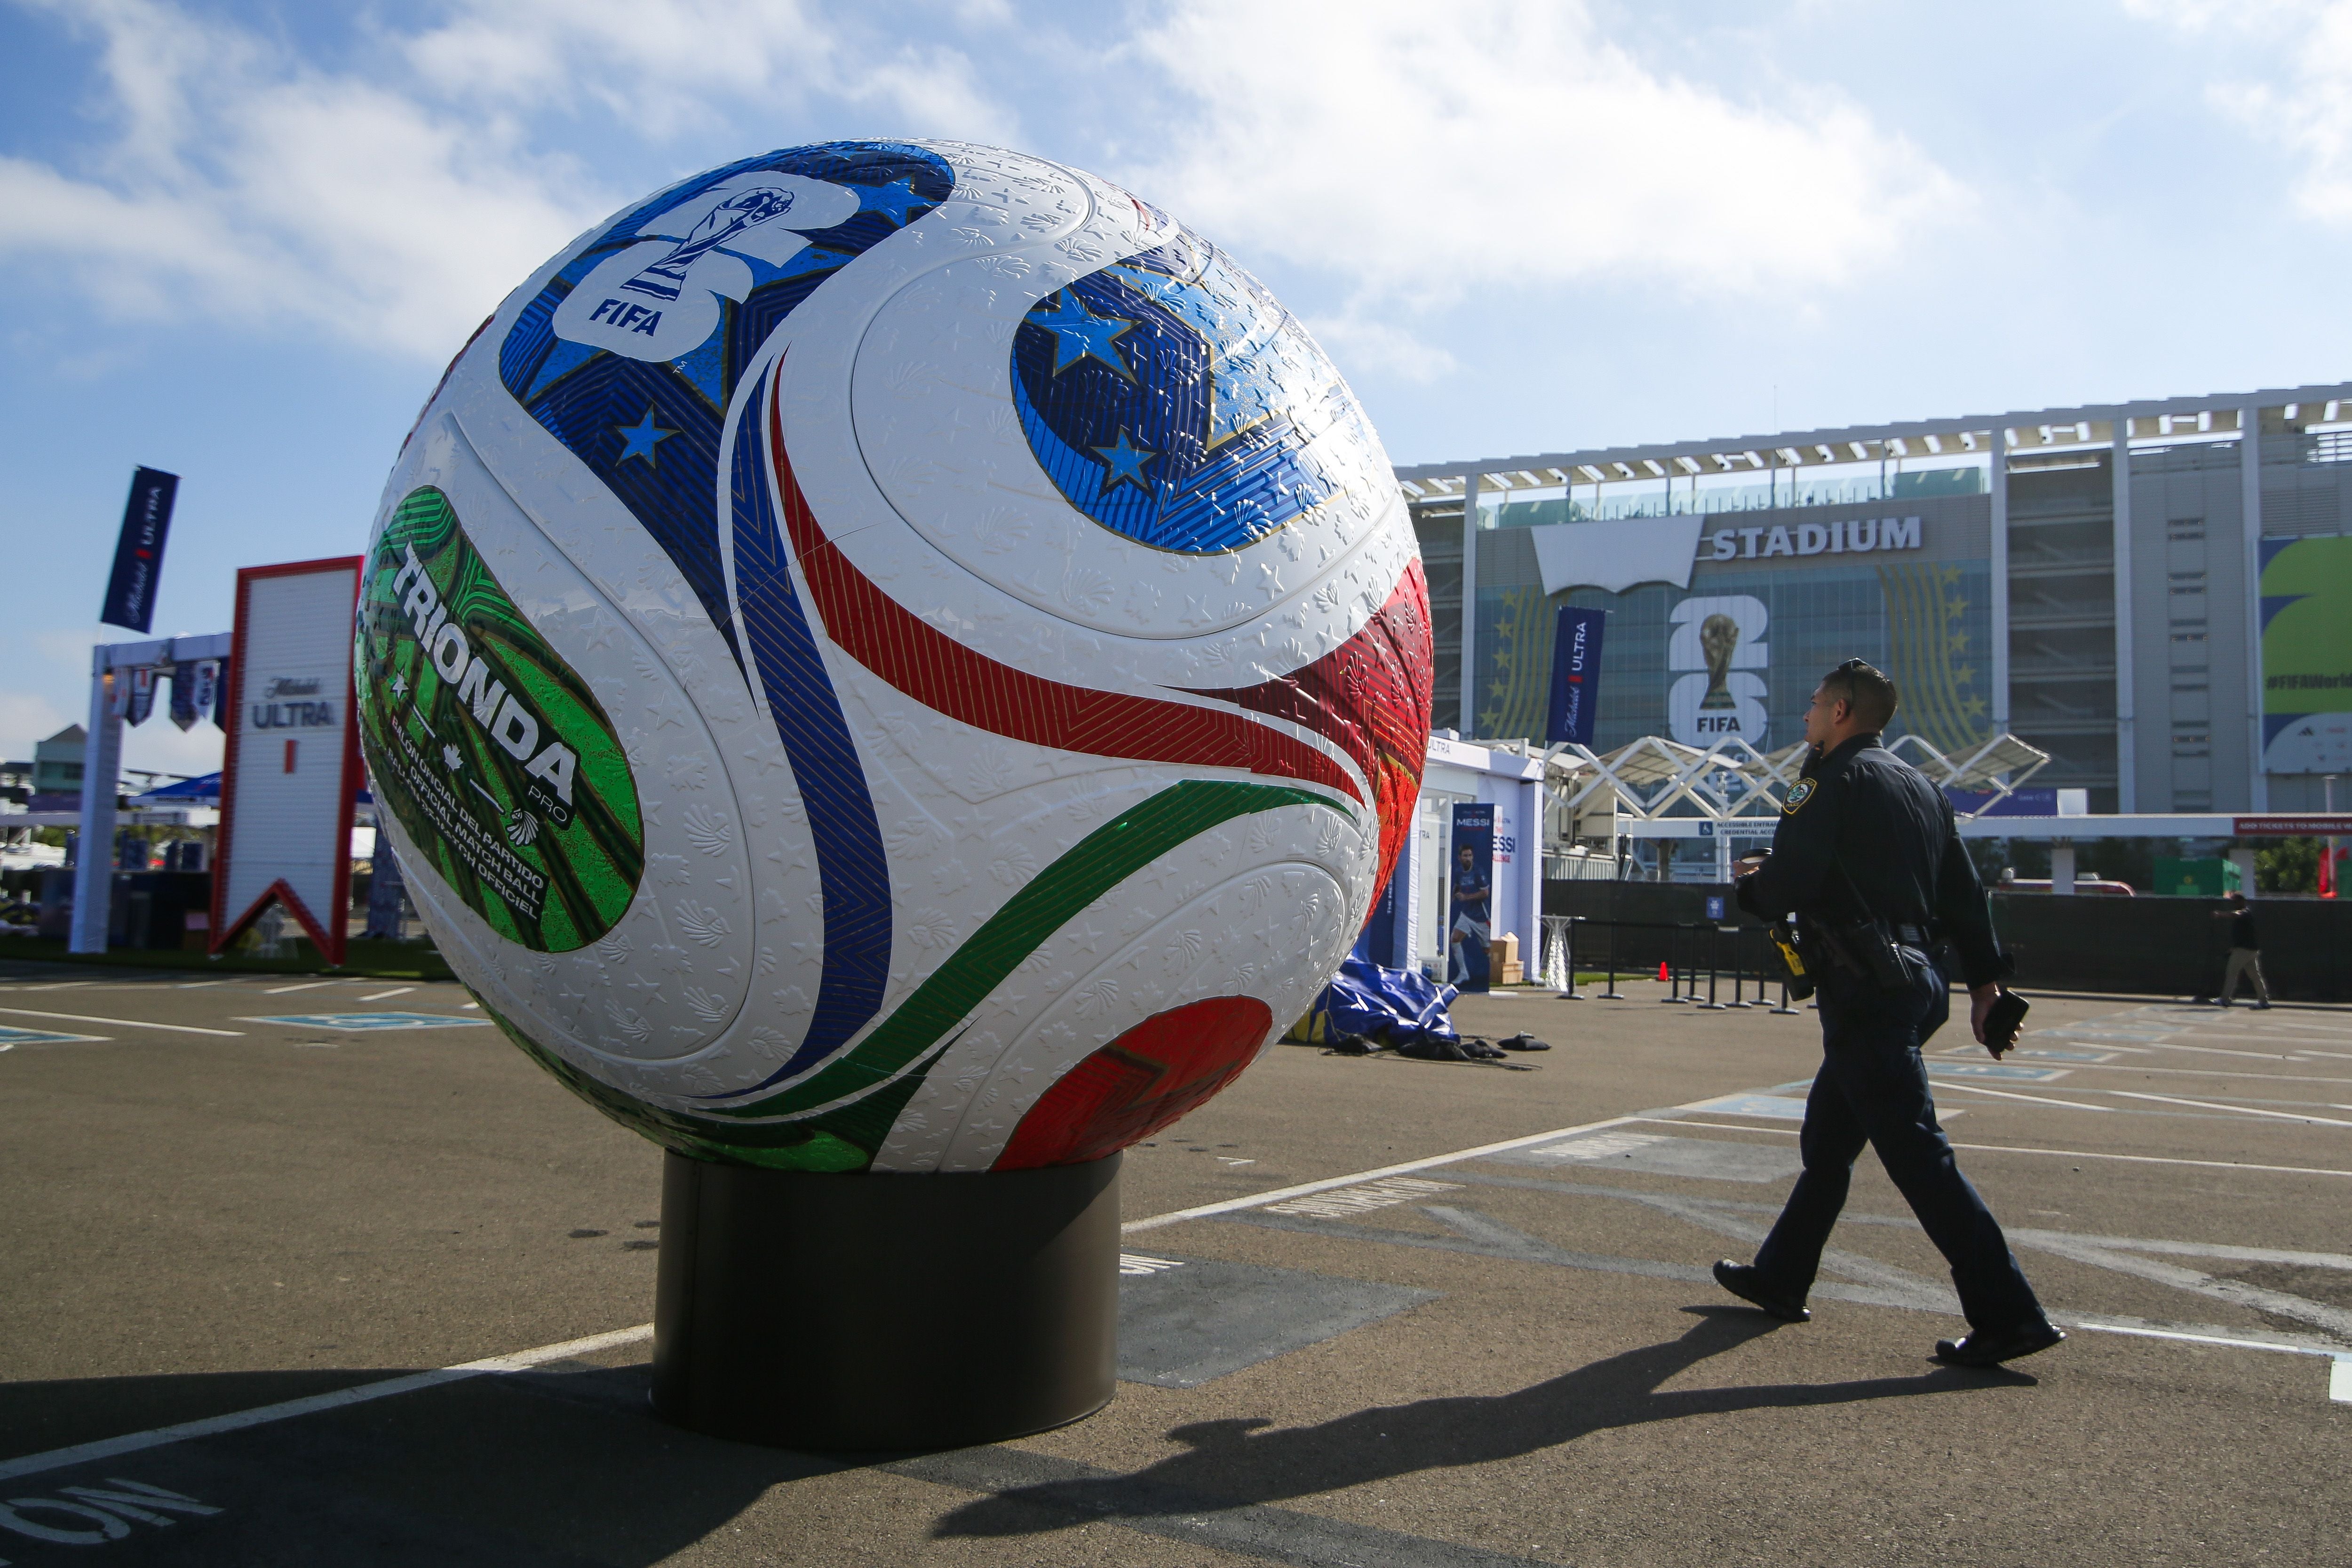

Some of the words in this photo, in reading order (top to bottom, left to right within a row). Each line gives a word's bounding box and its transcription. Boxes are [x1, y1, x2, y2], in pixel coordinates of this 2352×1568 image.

[588, 298, 663, 338] FIFA
[672, 360, 688, 374] TM
[141, 485, 163, 545] ULTRA
[1712, 516, 1923, 561] STADIUM
[1572, 621, 1587, 671] ULTRA
[393, 541, 577, 805] TRIONDA
[253, 701, 335, 729] ULTRA
[1697, 716, 1740, 732] FIFA
[393, 716, 419, 763] BALÓN
[419, 758, 458, 812] OFICIAL
[460, 807, 481, 837] DEL
[483, 831, 544, 889] PARTIDO
[528, 785, 568, 822] PRO
[1456, 818, 1490, 827] MESSI
[411, 766, 453, 827] OFFICIAL
[455, 822, 501, 872] MATCH
[503, 868, 540, 905] BALL
[478, 863, 537, 919] OFFICIEL
